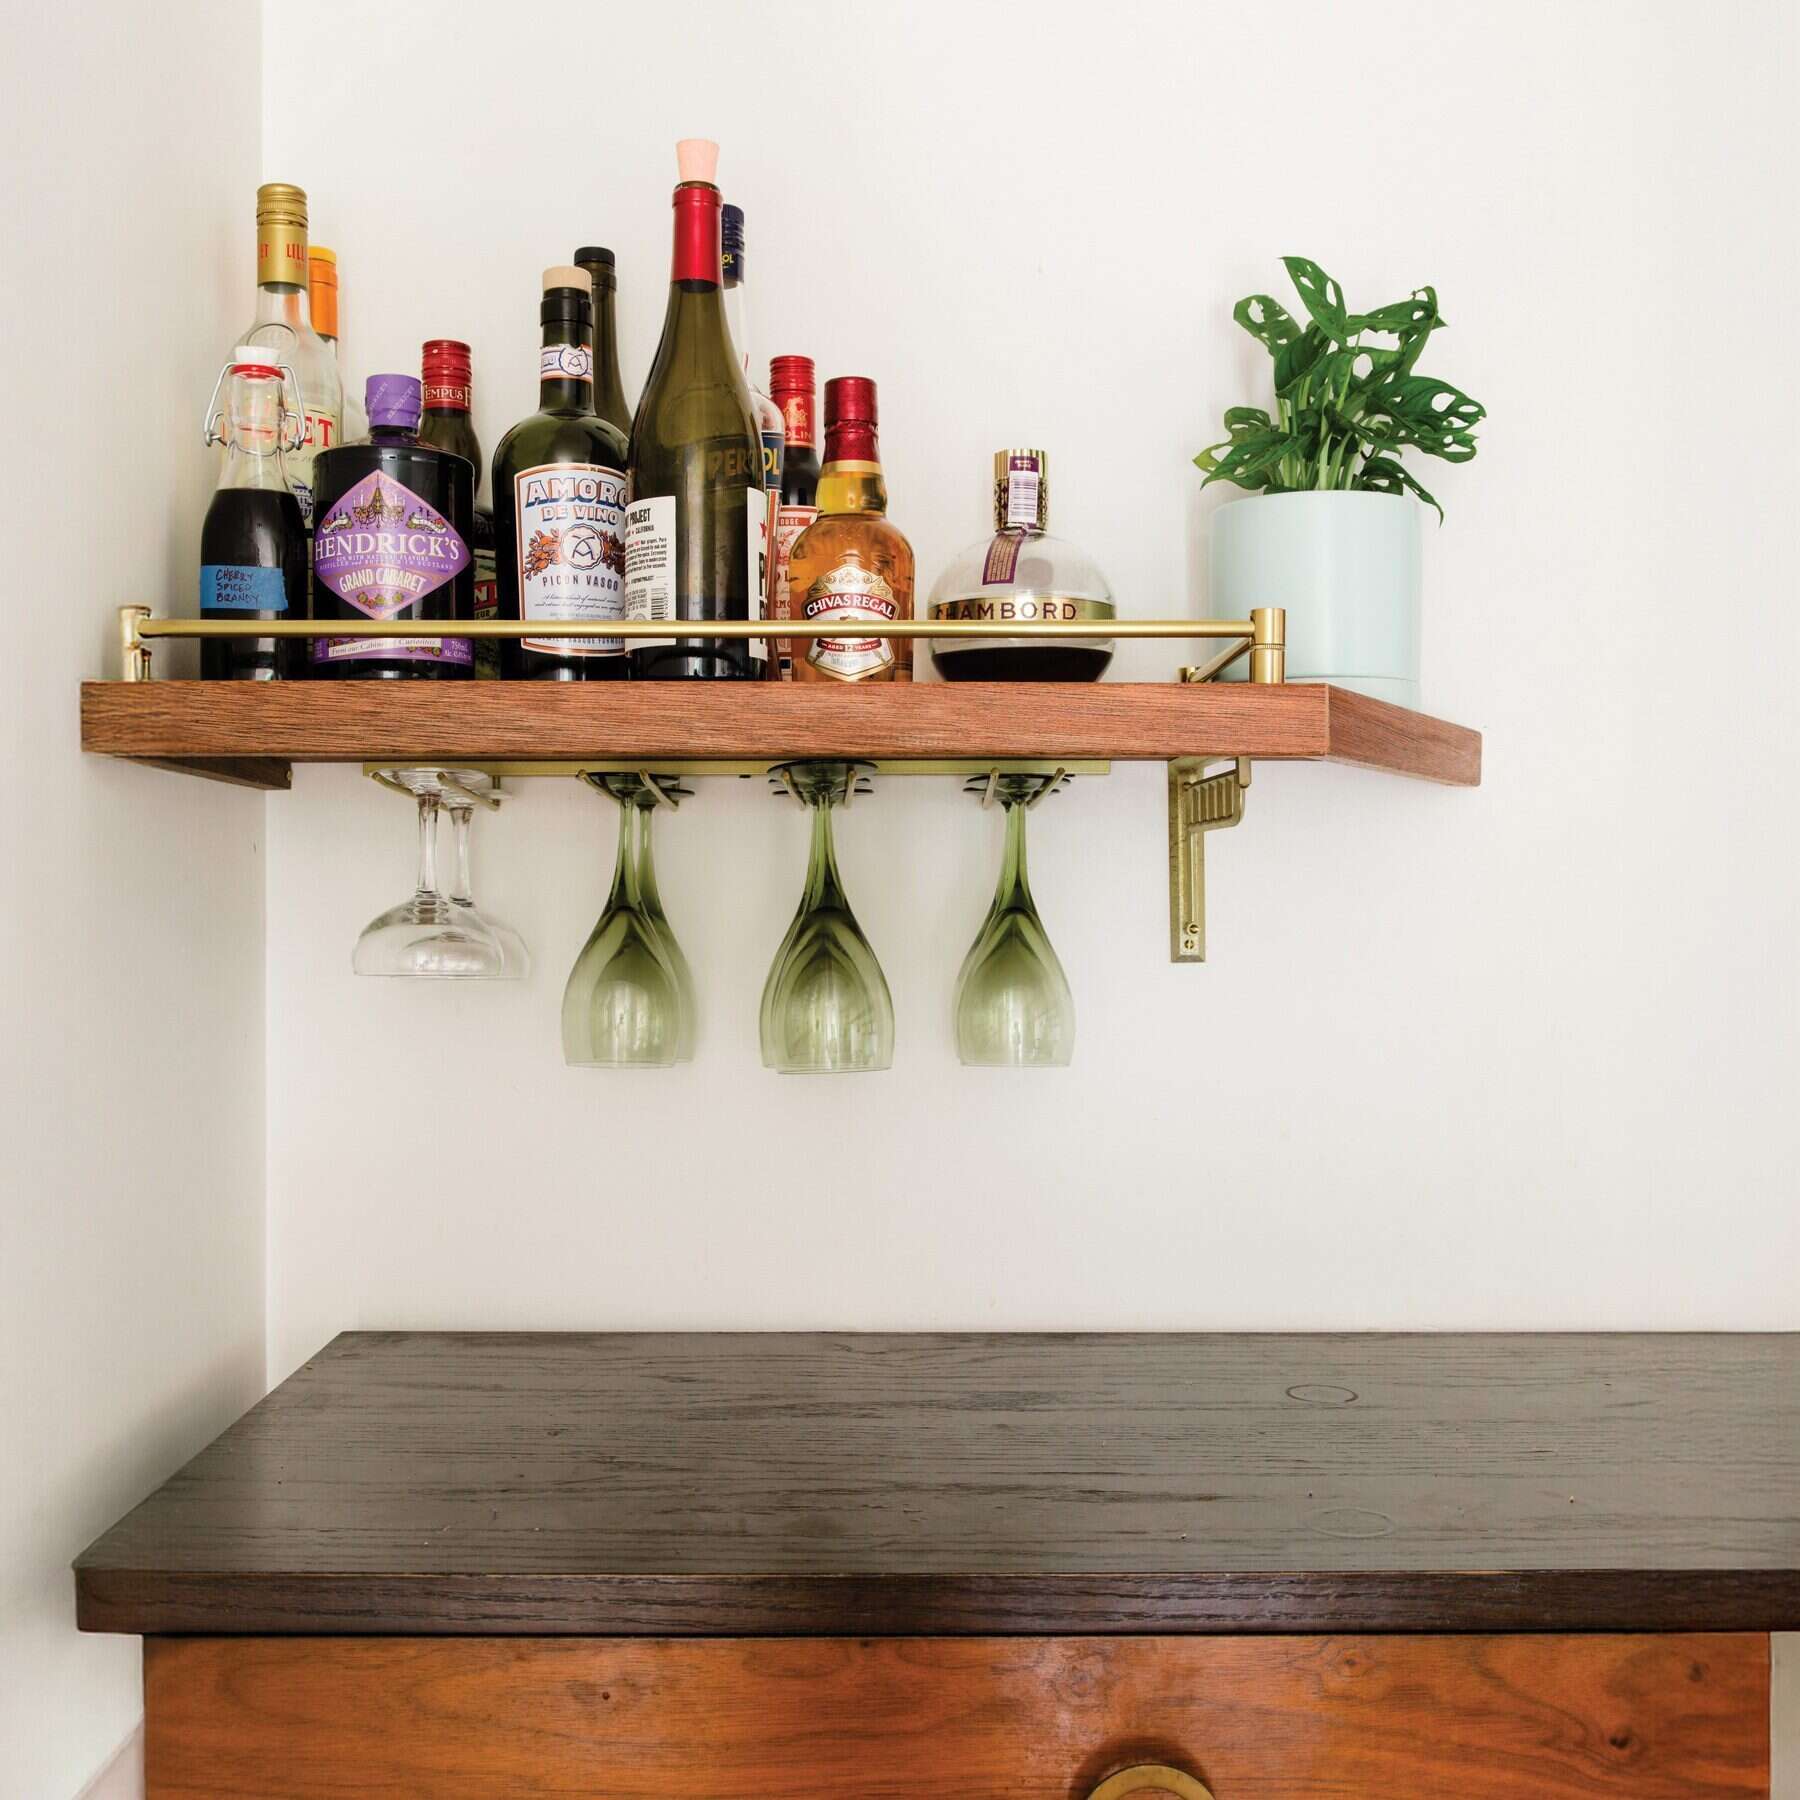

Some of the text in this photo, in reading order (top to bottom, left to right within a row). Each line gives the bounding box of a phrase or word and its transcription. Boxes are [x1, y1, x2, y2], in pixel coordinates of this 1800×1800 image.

[542, 505, 568, 522] DE
[573, 505, 619, 526] VINO
[315, 533, 460, 561] HENDRICK'S
[340, 567, 427, 593] GRAND CABARET
[806, 594, 893, 618] CHIVAS REGAL
[844, 643, 853, 652] 12
